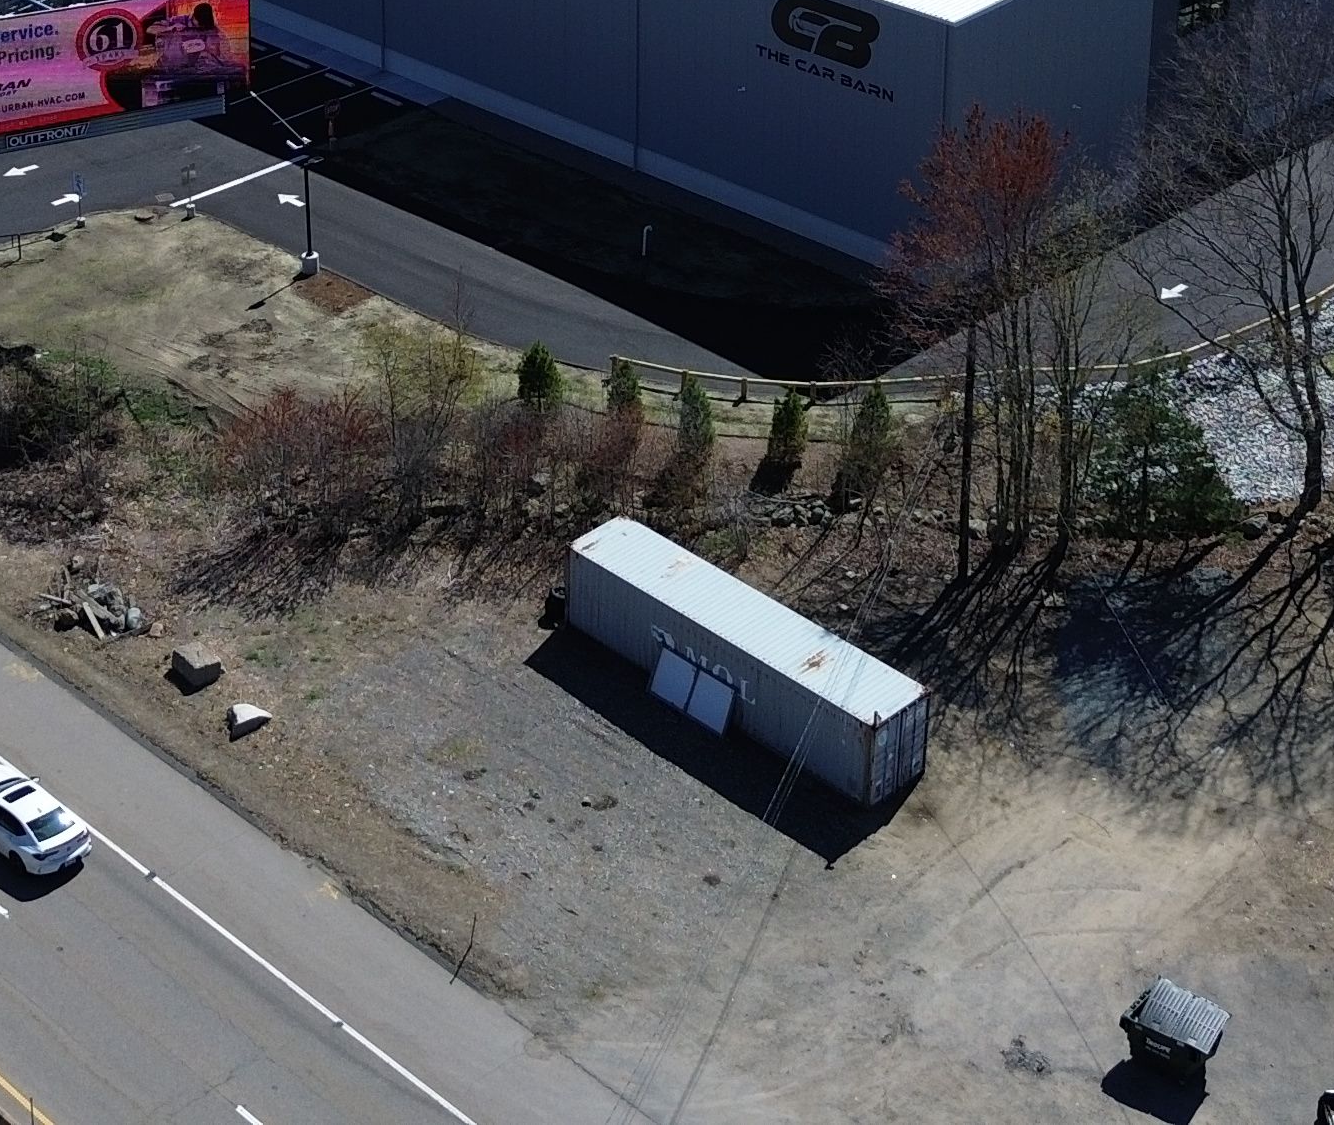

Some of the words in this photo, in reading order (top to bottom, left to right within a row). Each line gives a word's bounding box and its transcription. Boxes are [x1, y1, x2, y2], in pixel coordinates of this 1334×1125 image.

[89, 22, 125, 52] 61
[755, 44, 790, 66] THE
[794, 58, 836, 81] CAR
[840, 75, 894, 103] BARN
